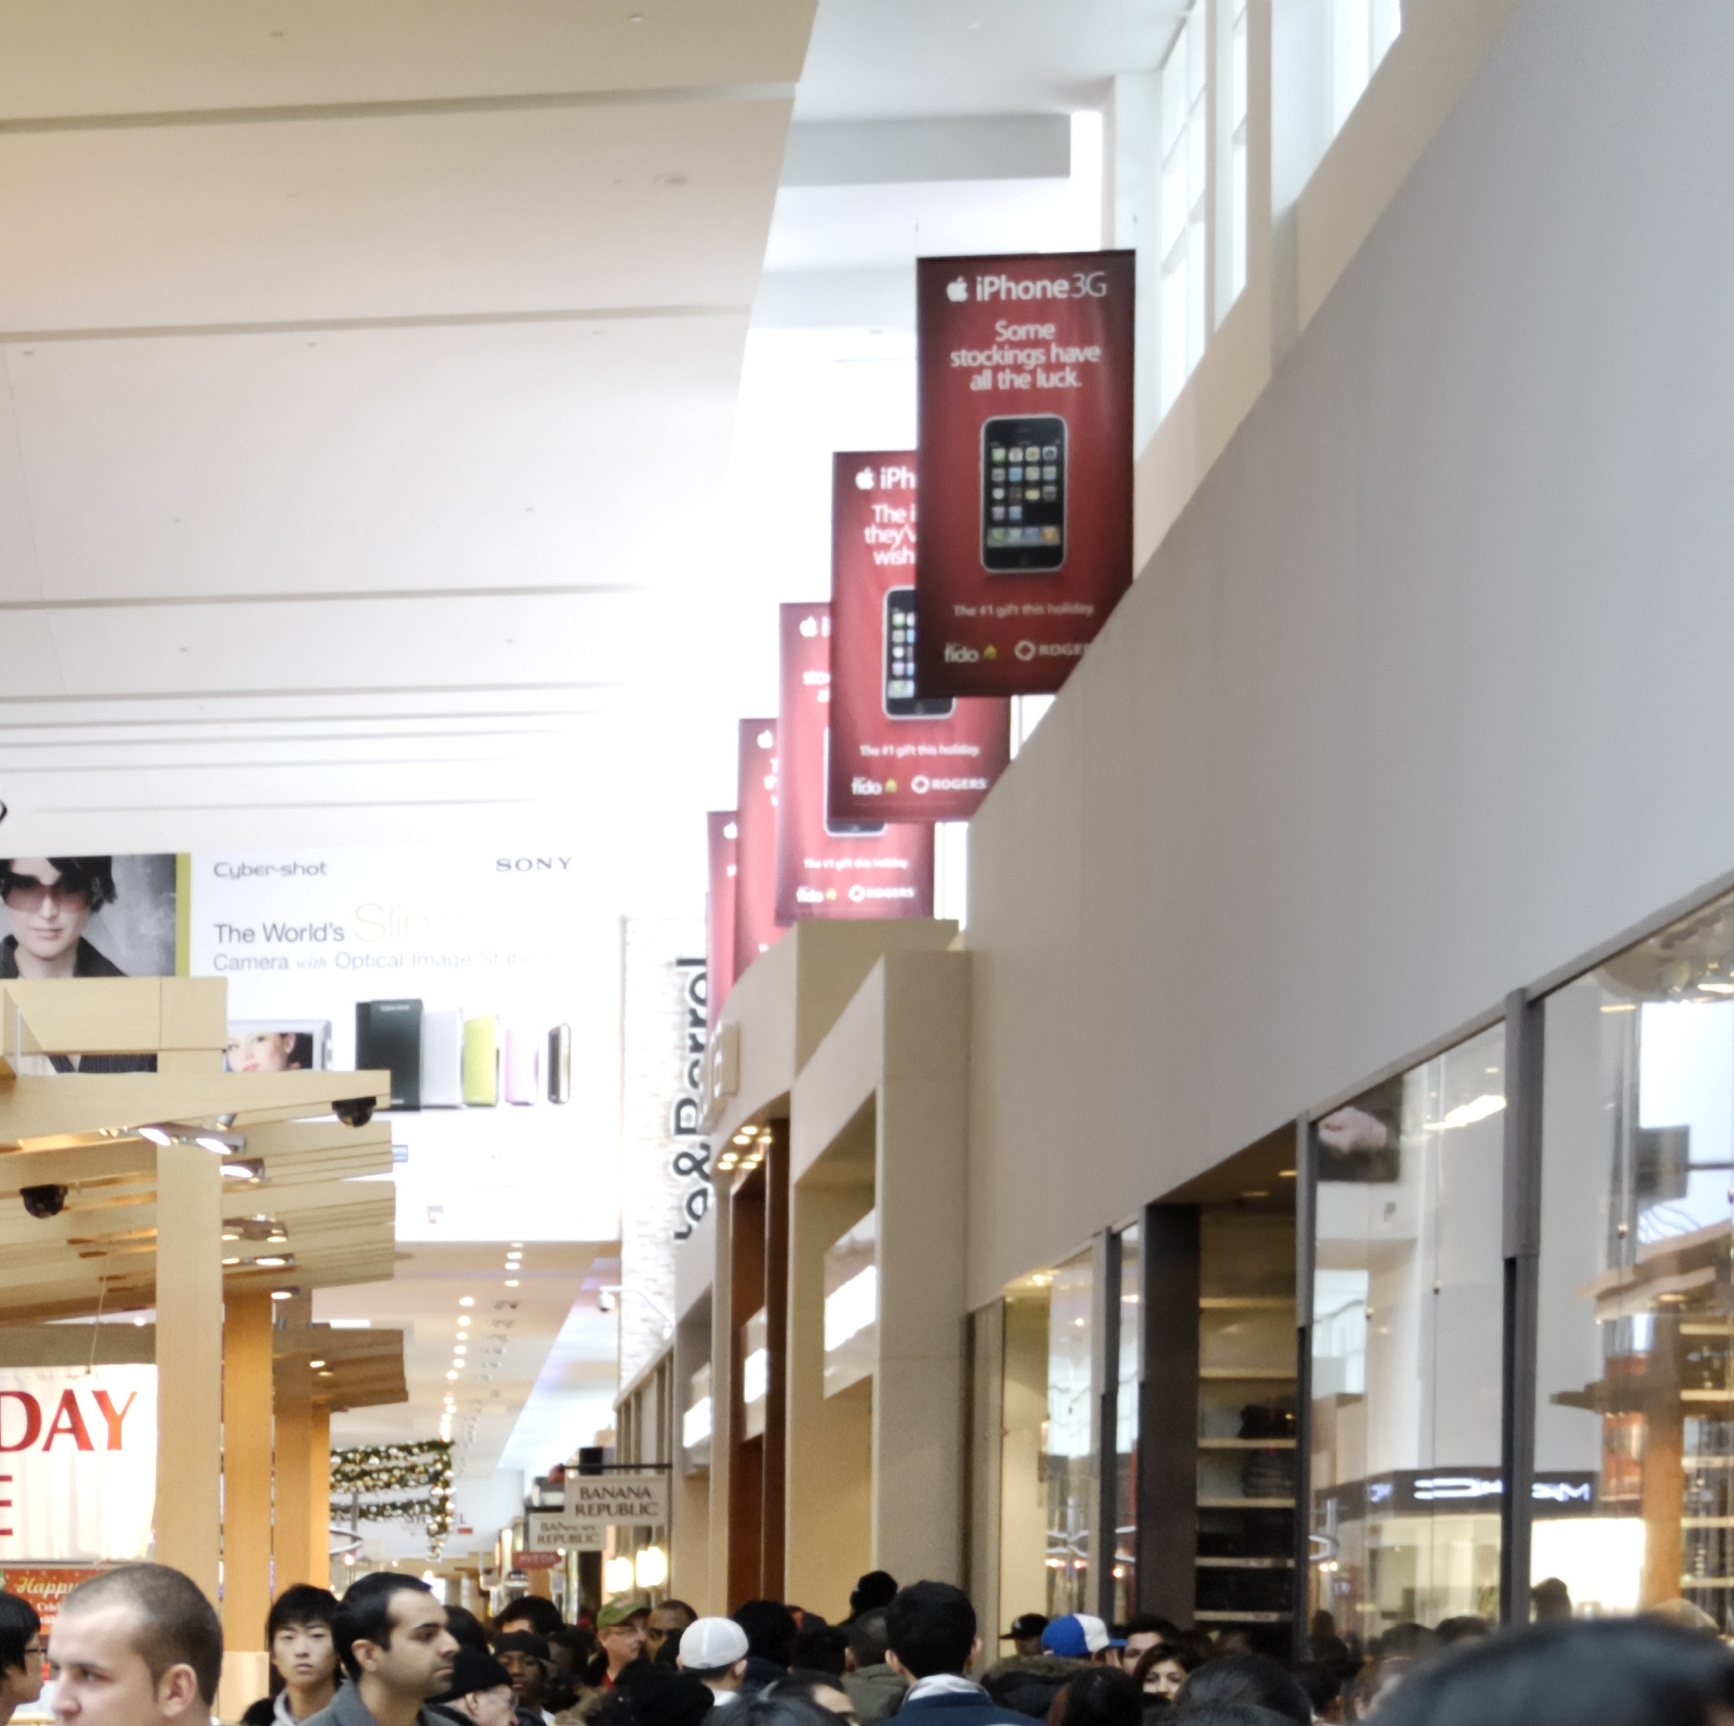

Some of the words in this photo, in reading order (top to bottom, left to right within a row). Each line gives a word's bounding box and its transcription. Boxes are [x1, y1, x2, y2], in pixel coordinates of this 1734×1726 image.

[995, 320, 1056, 342] Some
[950, 345, 1046, 369] stockings
[1050, 343, 1102, 364] have
[970, 370, 994, 391] all
[997, 368, 1032, 390] the
[1036, 366, 1084, 389] luck.
[871, 503, 907, 525] The
[953, 604, 977, 617] The
[996, 603, 1020, 620] gift
[1021, 603, 1046, 616] this
[944, 645, 980, 664] fido
[859, 744, 882, 757] The
[850, 779, 883, 796] fido
[931, 777, 988, 791] ROGERS
[212, 861, 329, 881] Cyber-shot
[495, 856, 573, 873] SONY
[213, 922, 256, 945] The
[262, 920, 346, 944] World's
[213, 952, 290, 973] Camera
[295, 954, 329, 970] with
[334, 950, 405, 973] Optical
[579, 1485, 652, 1501] BANANA
[574, 1502, 659, 1518] REPUBLIC
[536, 1534, 599, 1546] REPUBLIC
